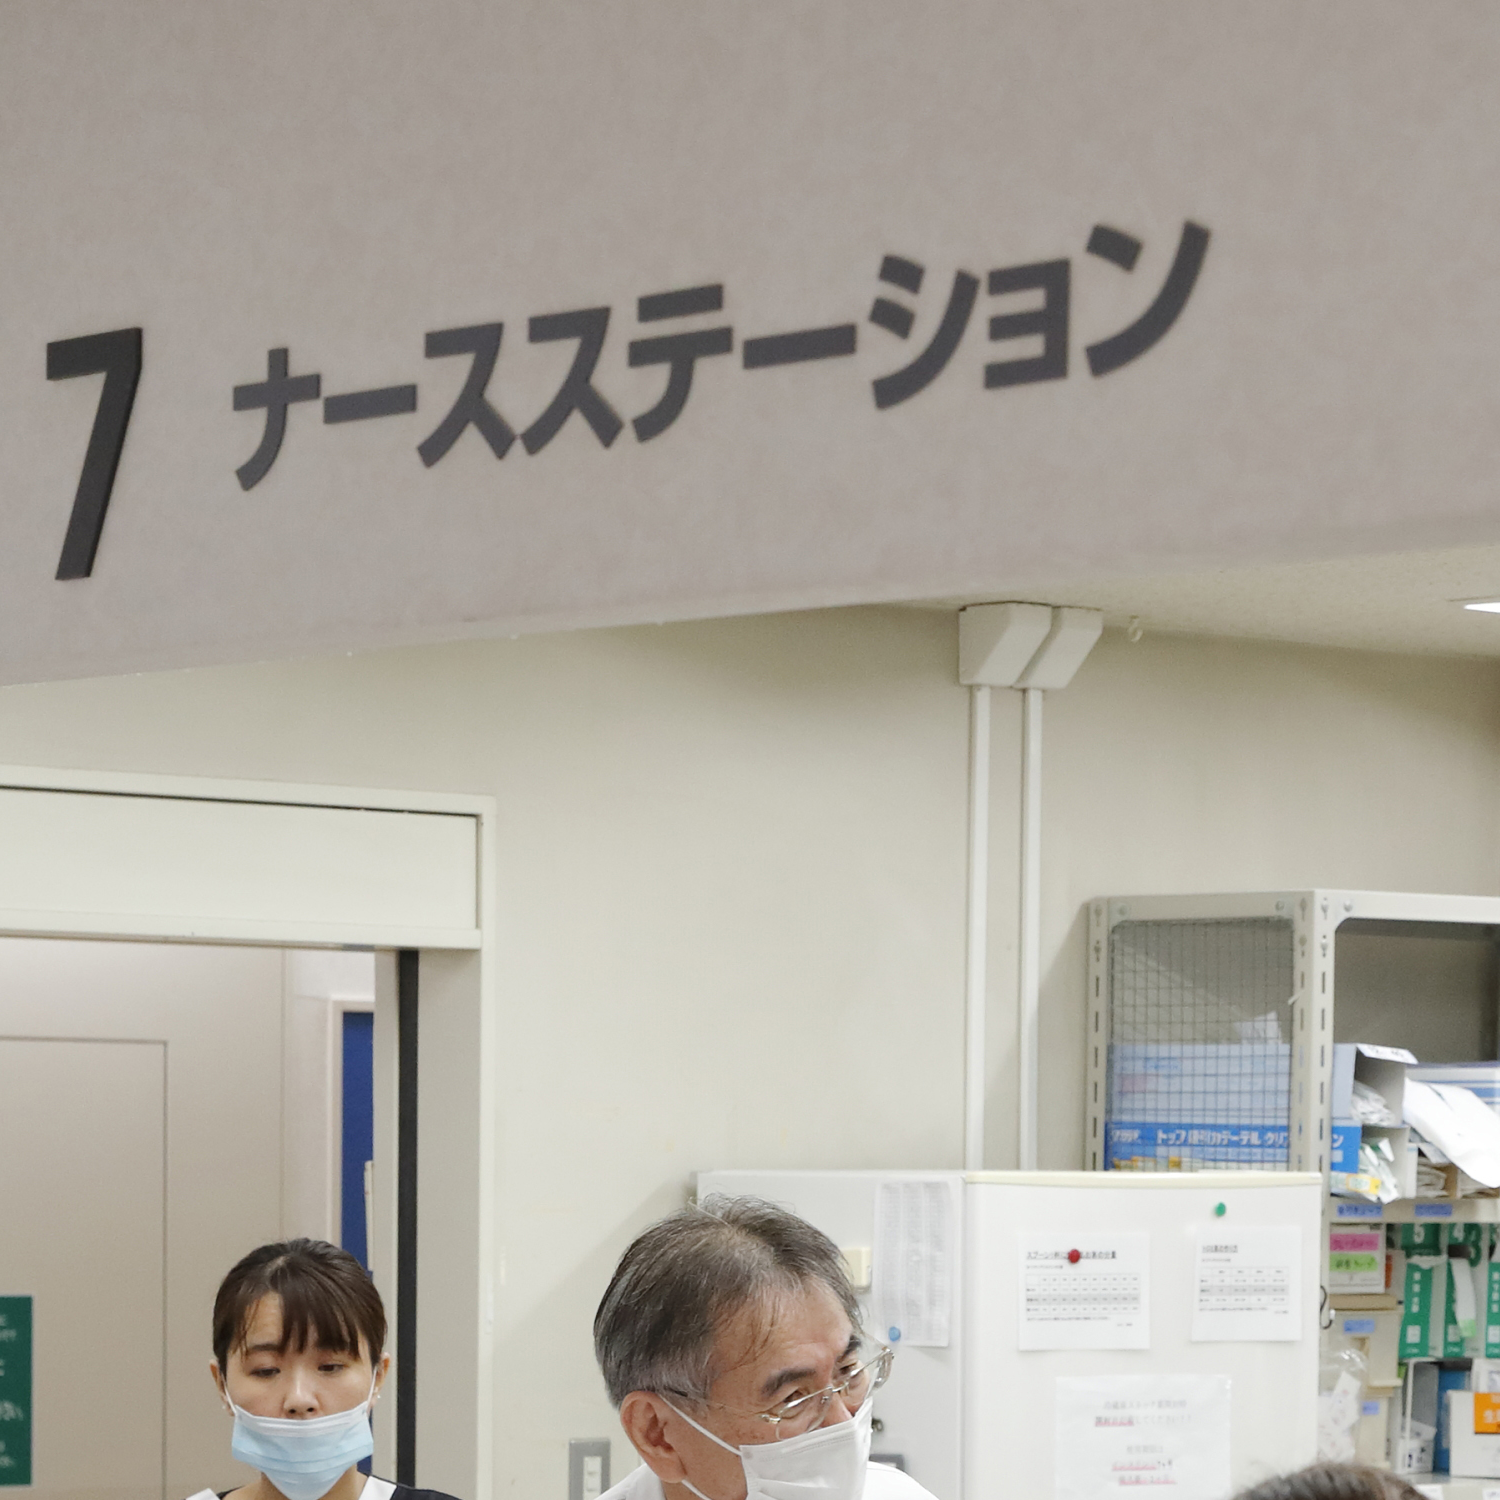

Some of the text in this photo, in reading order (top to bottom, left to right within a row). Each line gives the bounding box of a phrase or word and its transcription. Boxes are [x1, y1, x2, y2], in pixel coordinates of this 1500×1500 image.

[46, 219, 1211, 581] 7 ナースステーション
